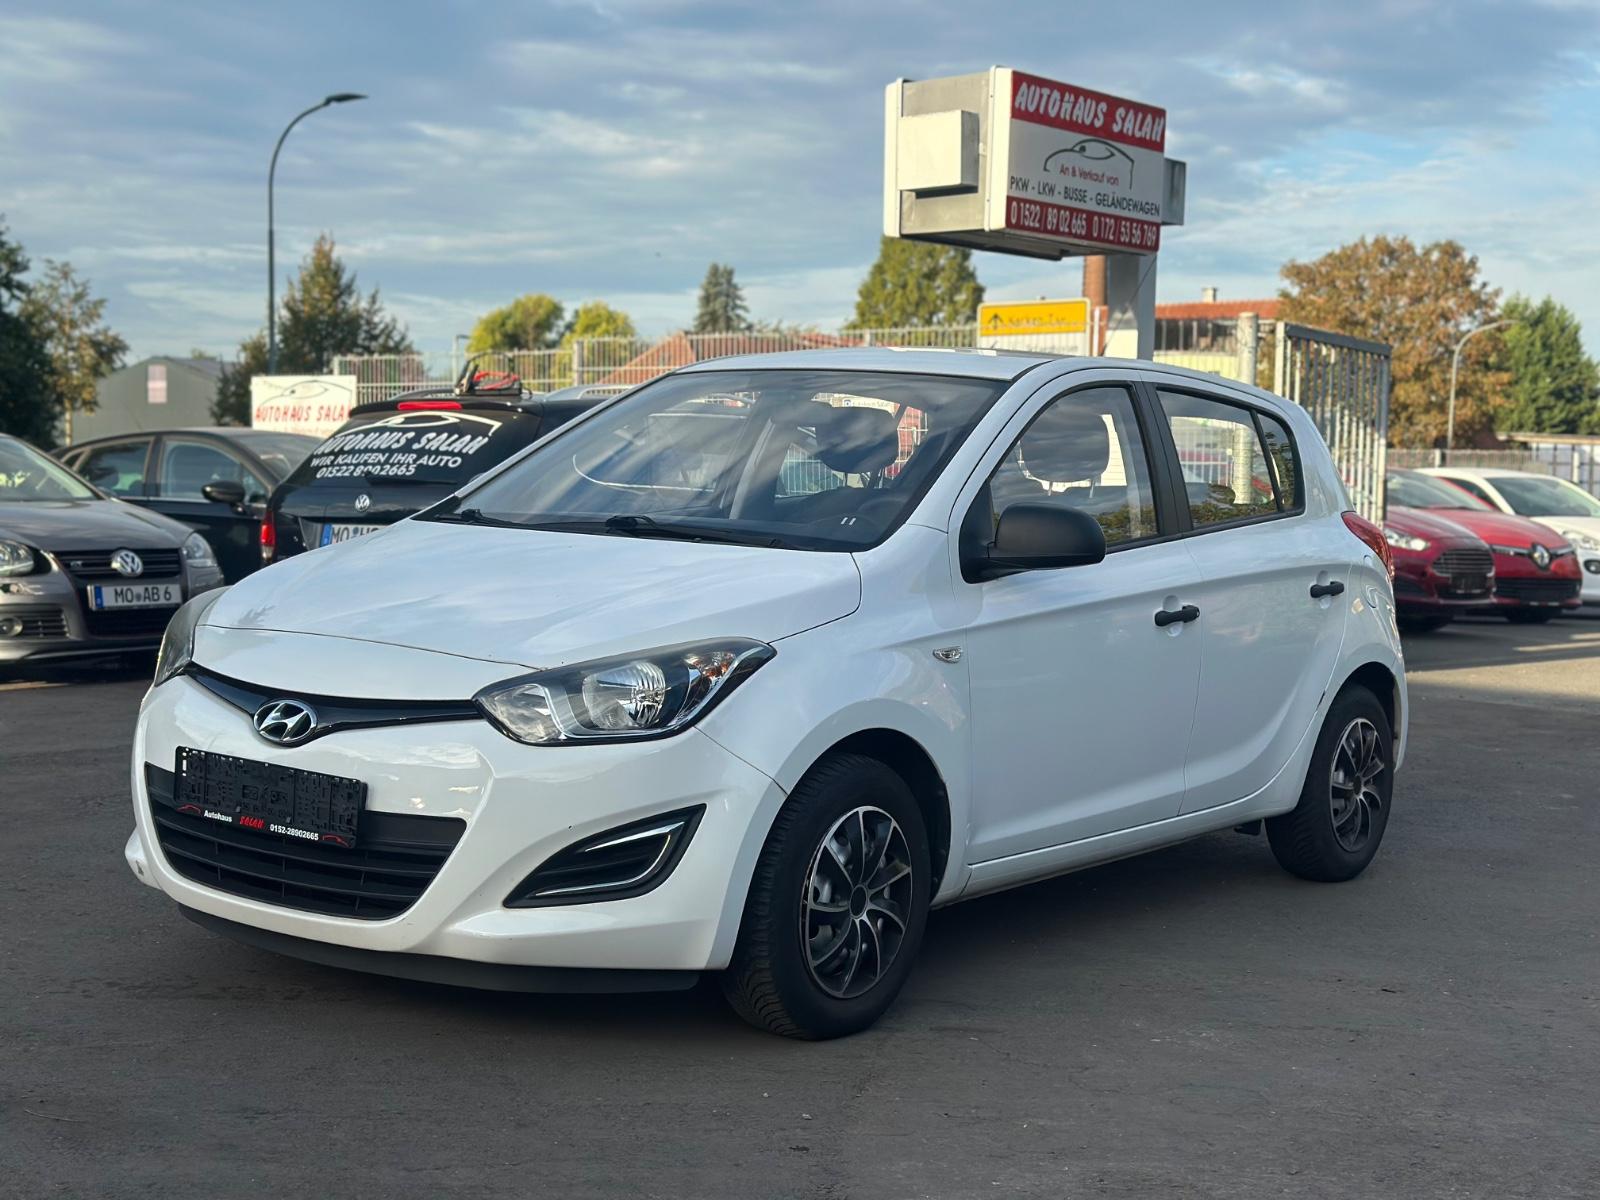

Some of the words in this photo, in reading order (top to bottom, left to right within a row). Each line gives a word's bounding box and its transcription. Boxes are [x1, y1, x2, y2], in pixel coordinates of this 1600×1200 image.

[1014, 81, 1107, 128] AUTOHAUS
[1112, 106, 1165, 142] SALAH
[1059, 164, 1069, 176] An
[1078, 168, 1105, 184] Verkauf
[1106, 176, 1119, 186] von
[1010, 176, 1030, 192] PKW
[1037, 181, 1056, 197] LKW
[1063, 186, 1088, 204] BUSSE
[1095, 191, 1160, 217] GELÄNDEWAGEN
[1010, 200, 1018, 225] 0
[1020, 202, 1041, 228] 1522
[1046, 207, 1058, 231] 89
[1059, 209, 1071, 233] 02
[1071, 212, 1087, 236] 665
[1092, 215, 1099, 238] 0
[1120, 220, 1130, 243] 53
[1131, 222, 1141, 245] 56
[255, 405, 311, 422] AUTOHAUS
[314, 431, 415, 455] AUTOHAUS
[412, 432, 489, 455] SALAH
[310, 455, 333, 467] WIR
[334, 452, 388, 465] KAUFEN
[389, 452, 418, 465] IHR
[416, 454, 462, 468] AUTO
[114, 587, 134, 603] MO
[143, 586, 160, 602] AB
[203, 809, 233, 823] Autohaus
[269, 823, 319, 841] 0152-28902665
